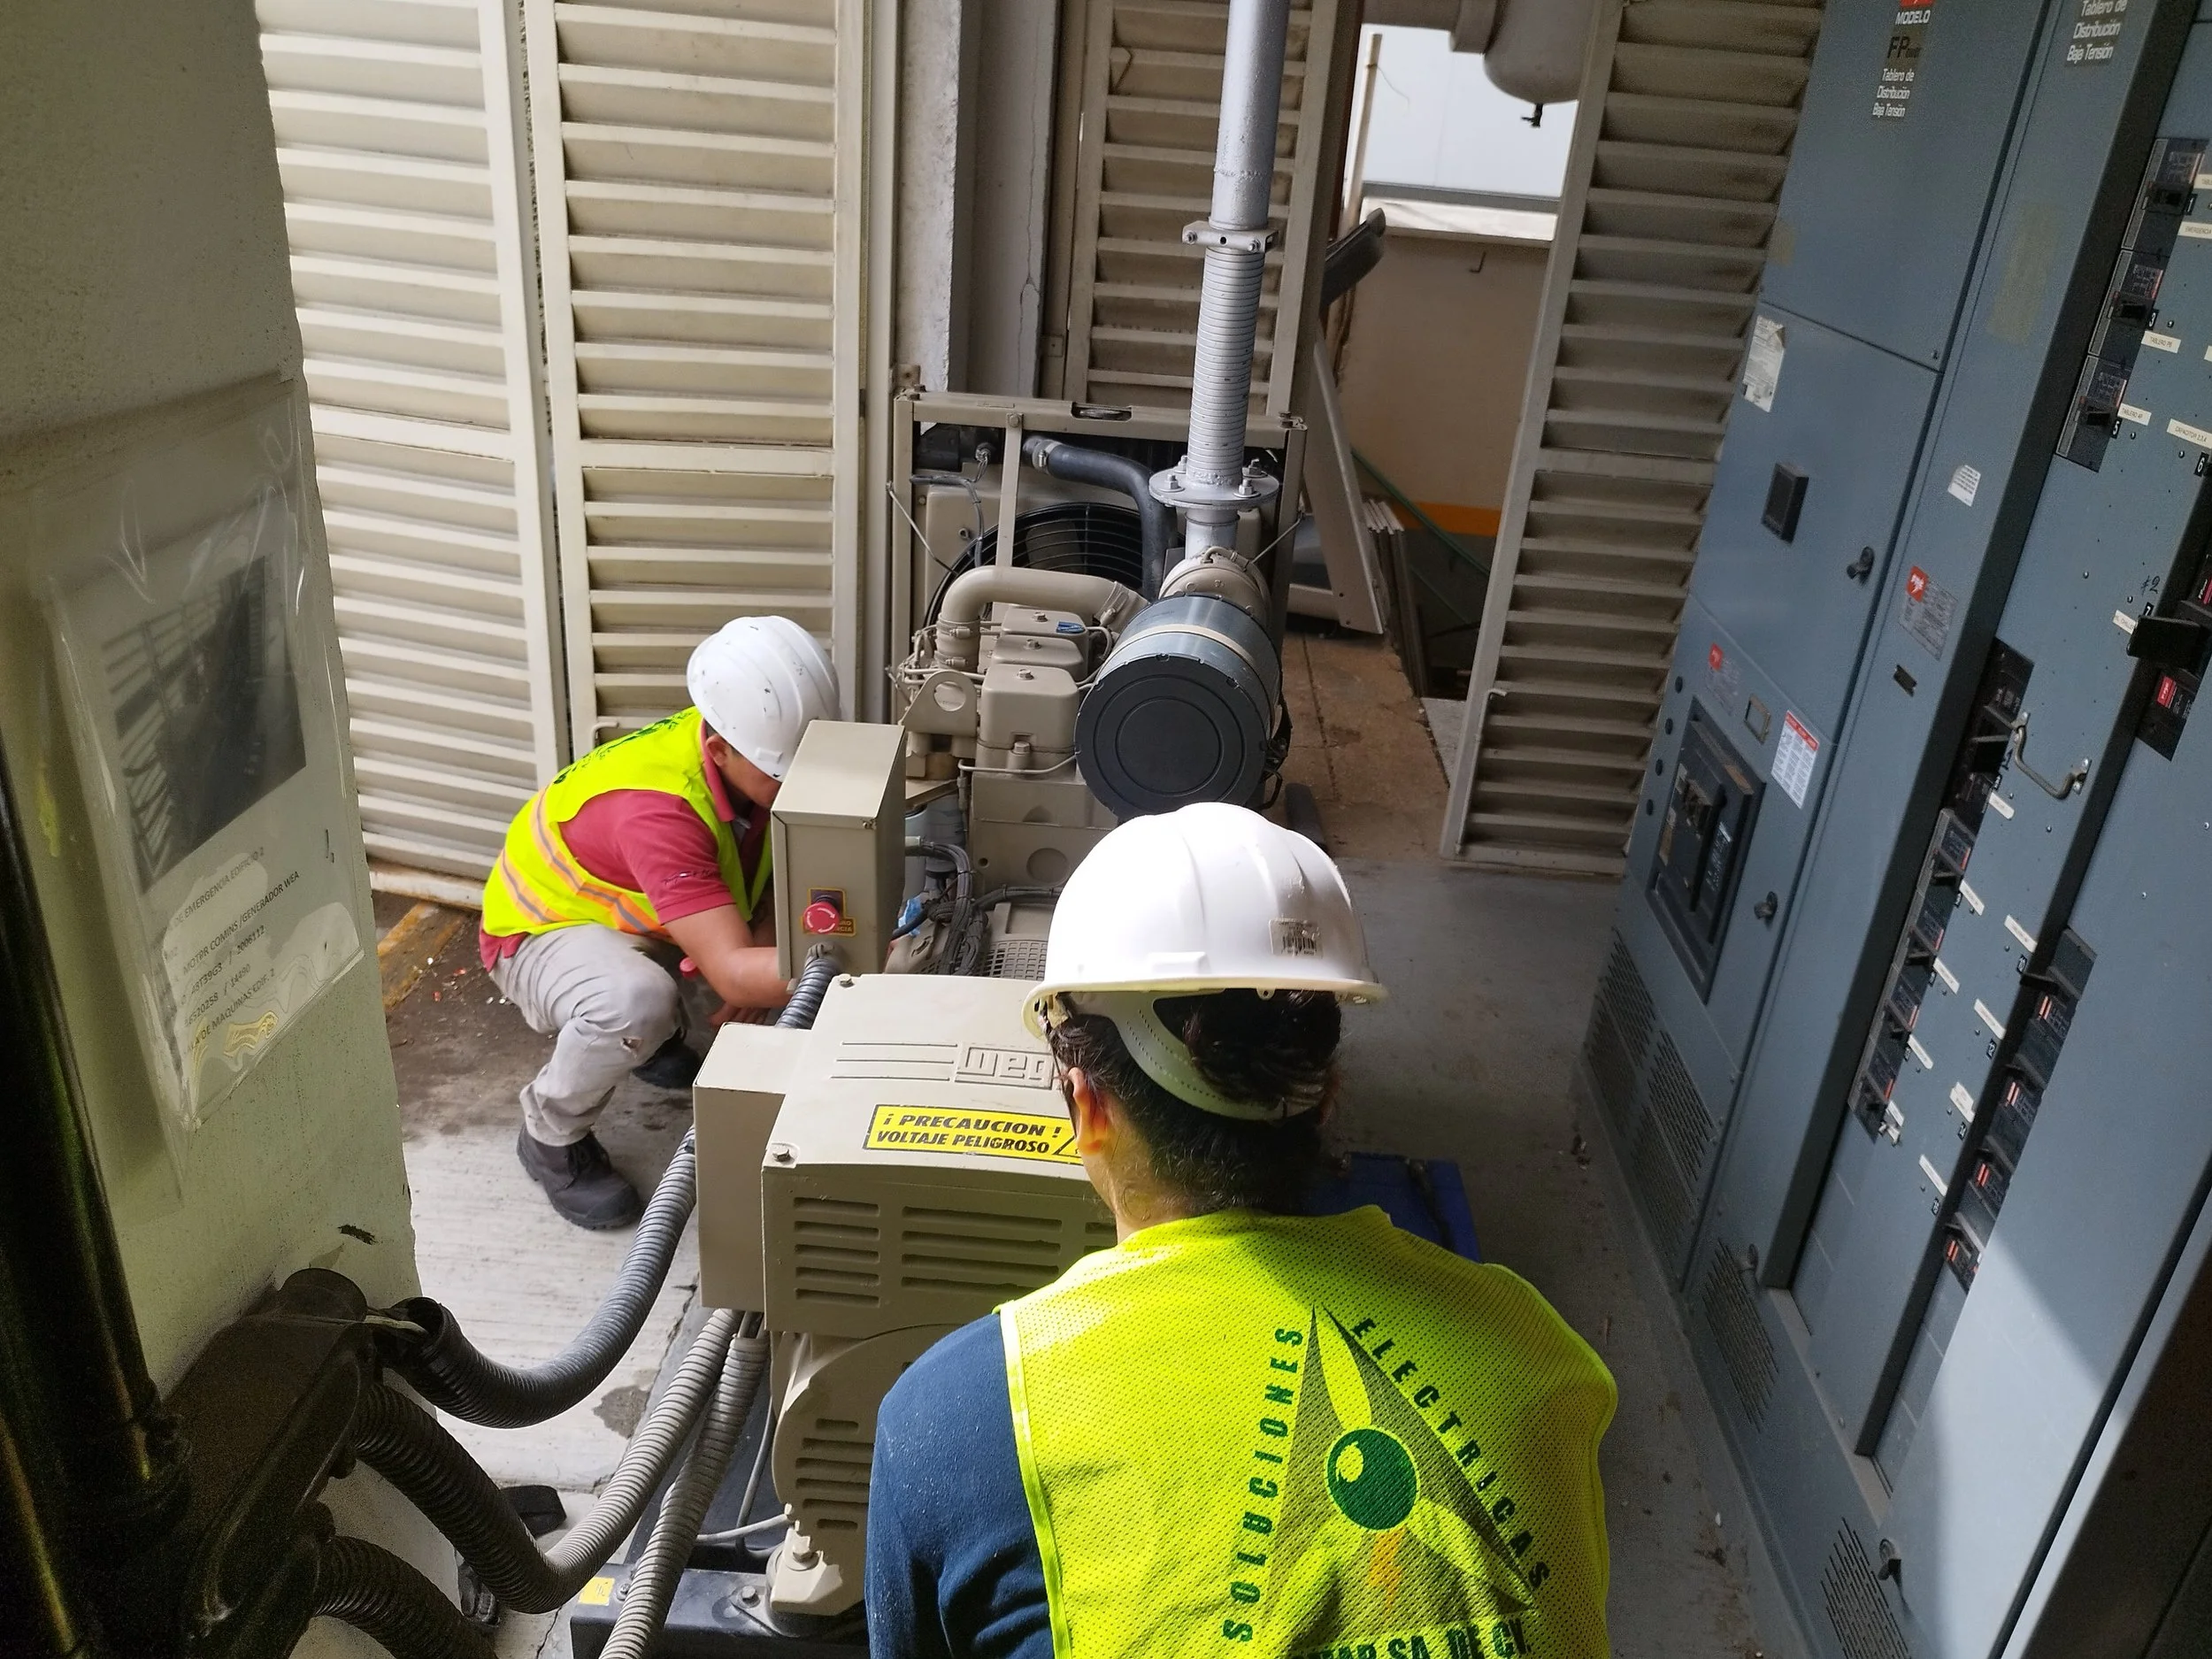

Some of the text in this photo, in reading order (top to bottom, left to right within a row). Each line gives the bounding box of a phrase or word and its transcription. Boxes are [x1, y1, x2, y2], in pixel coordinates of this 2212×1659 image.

[1895, 10, 1931, 25] MODELO
[2081, 0, 2114, 16] Tablero
[2073, 19, 2121, 39] Distribución
[2067, 42, 2114, 64] Baja Tensión
[1882, 68, 1905, 81] Tablero
[1877, 85, 1910, 99] Distribución
[2148, 312, 2156, 327] 3
[2112, 420, 2120, 435] 5
[2197, 457, 2205, 472] 6
[184, 872, 231, 918] EMERGENCIA
[211, 987, 252, 1029] MAQUINAS
[899, 1114, 1048, 1137] PRECAUCION
[877, 1131, 1051, 1154] VOLTAJE PELIGROSO
[1350, 1317, 1550, 1590] ELECTRICAS
[1221, 1326, 1304, 1644] SOLUCIONES
